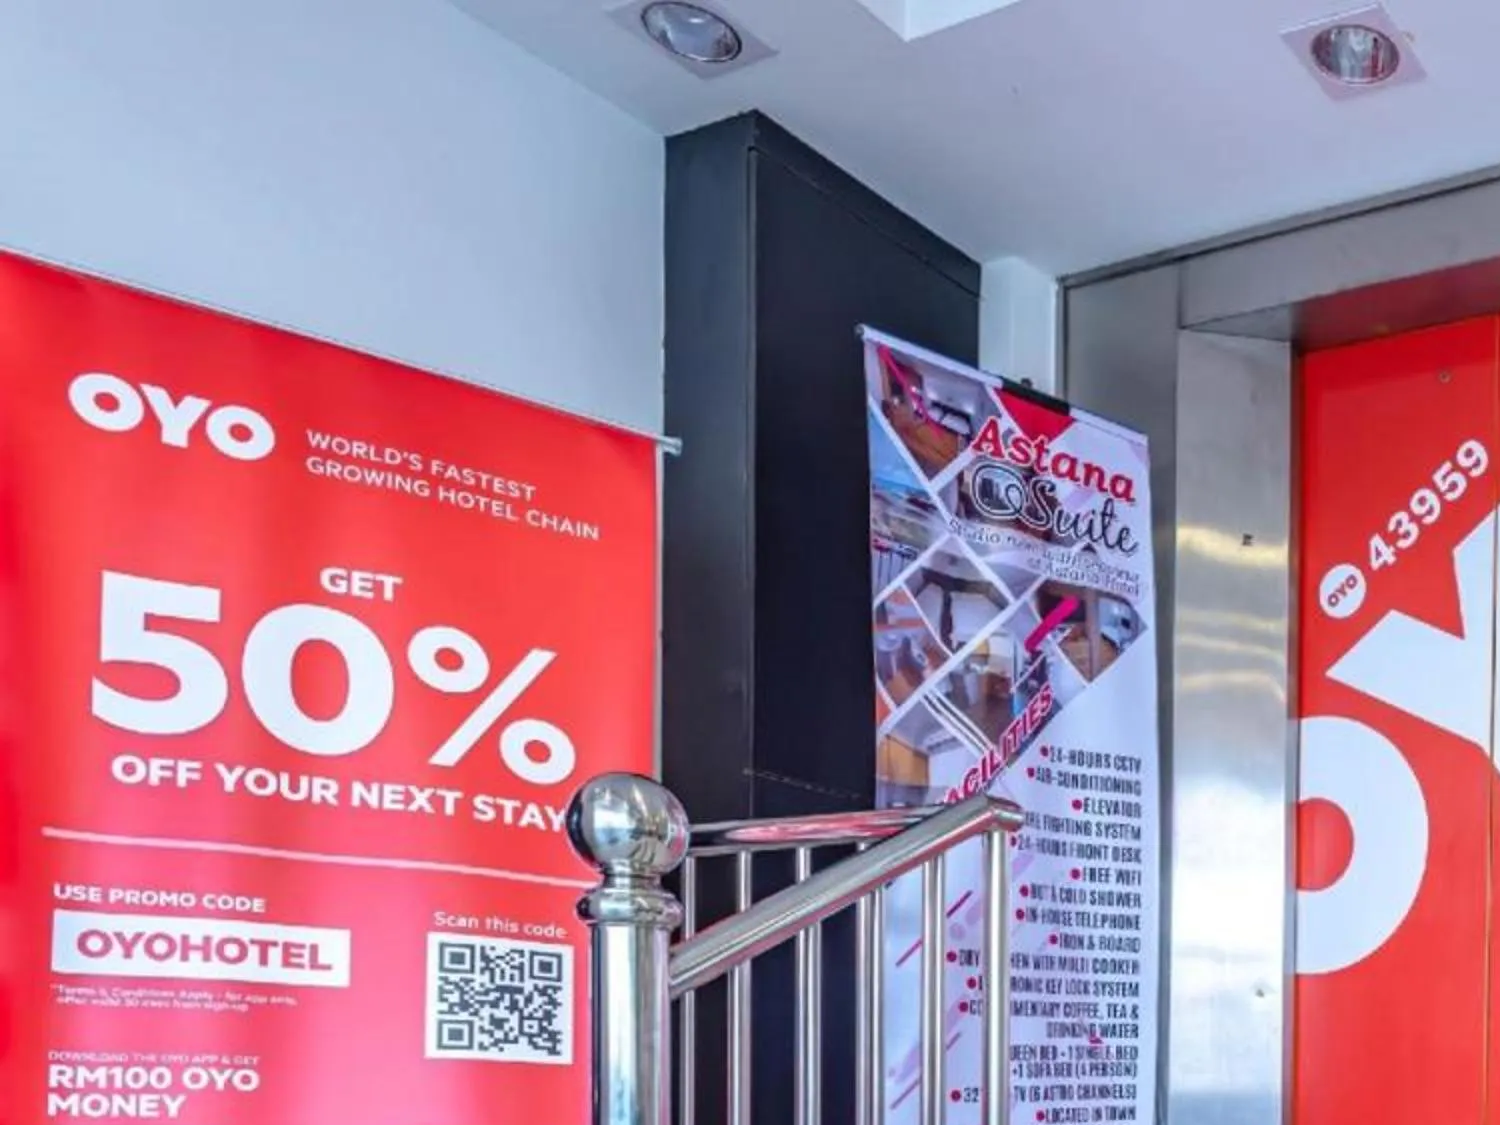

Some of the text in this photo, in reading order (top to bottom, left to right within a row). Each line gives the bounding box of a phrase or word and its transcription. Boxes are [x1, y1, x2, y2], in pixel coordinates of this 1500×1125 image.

[68, 373, 275, 460] OYO
[306, 430, 535, 501] WORLD'S FASTEST
[971, 415, 1137, 503] Astana
[306, 457, 600, 541] GROWING HOTEL CHAIN
[971, 464, 1140, 558] Suite
[1327, 438, 1489, 607] OYO 43959
[320, 567, 403, 602] GET
[91, 569, 577, 785] 50%
[1113, 754, 1142, 774] CCTV
[111, 755, 567, 833] OFF YOUR NEXT STAY
[1083, 797, 1142, 819] ELEVATOR
[1095, 820, 1142, 841] SYSTEM
[1111, 845, 1142, 864] DESK
[1083, 866, 1111, 884] FREE
[53, 883, 267, 914] USE PROMO CODE
[1089, 889, 1142, 909] SHOWER
[433, 910, 567, 941] Scan this code
[1075, 910, 1142, 931] TELEPHONE
[76, 928, 334, 973] OYOHOTEL
[1059, 932, 1085, 951] IRON
[1091, 957, 1141, 975] COOKER
[1045, 977, 1063, 995] KEY
[1065, 978, 1091, 996] LOCK
[1093, 980, 1140, 998] SYSTEM
[1106, 1002, 1127, 1019] TEA
[1129, 1003, 1139, 1020] &
[1099, 1022, 1139, 1039] WATER
[48, 1050, 128, 1064] DOWNLOAD
[1114, 1045, 1139, 1061] BED
[47, 1063, 261, 1093] RM100 OYO
[46, 1092, 187, 1118] MONEY
[1044, 1106, 1090, 1125] LOCATED
[1104, 1104, 1137, 1121] TOWN
